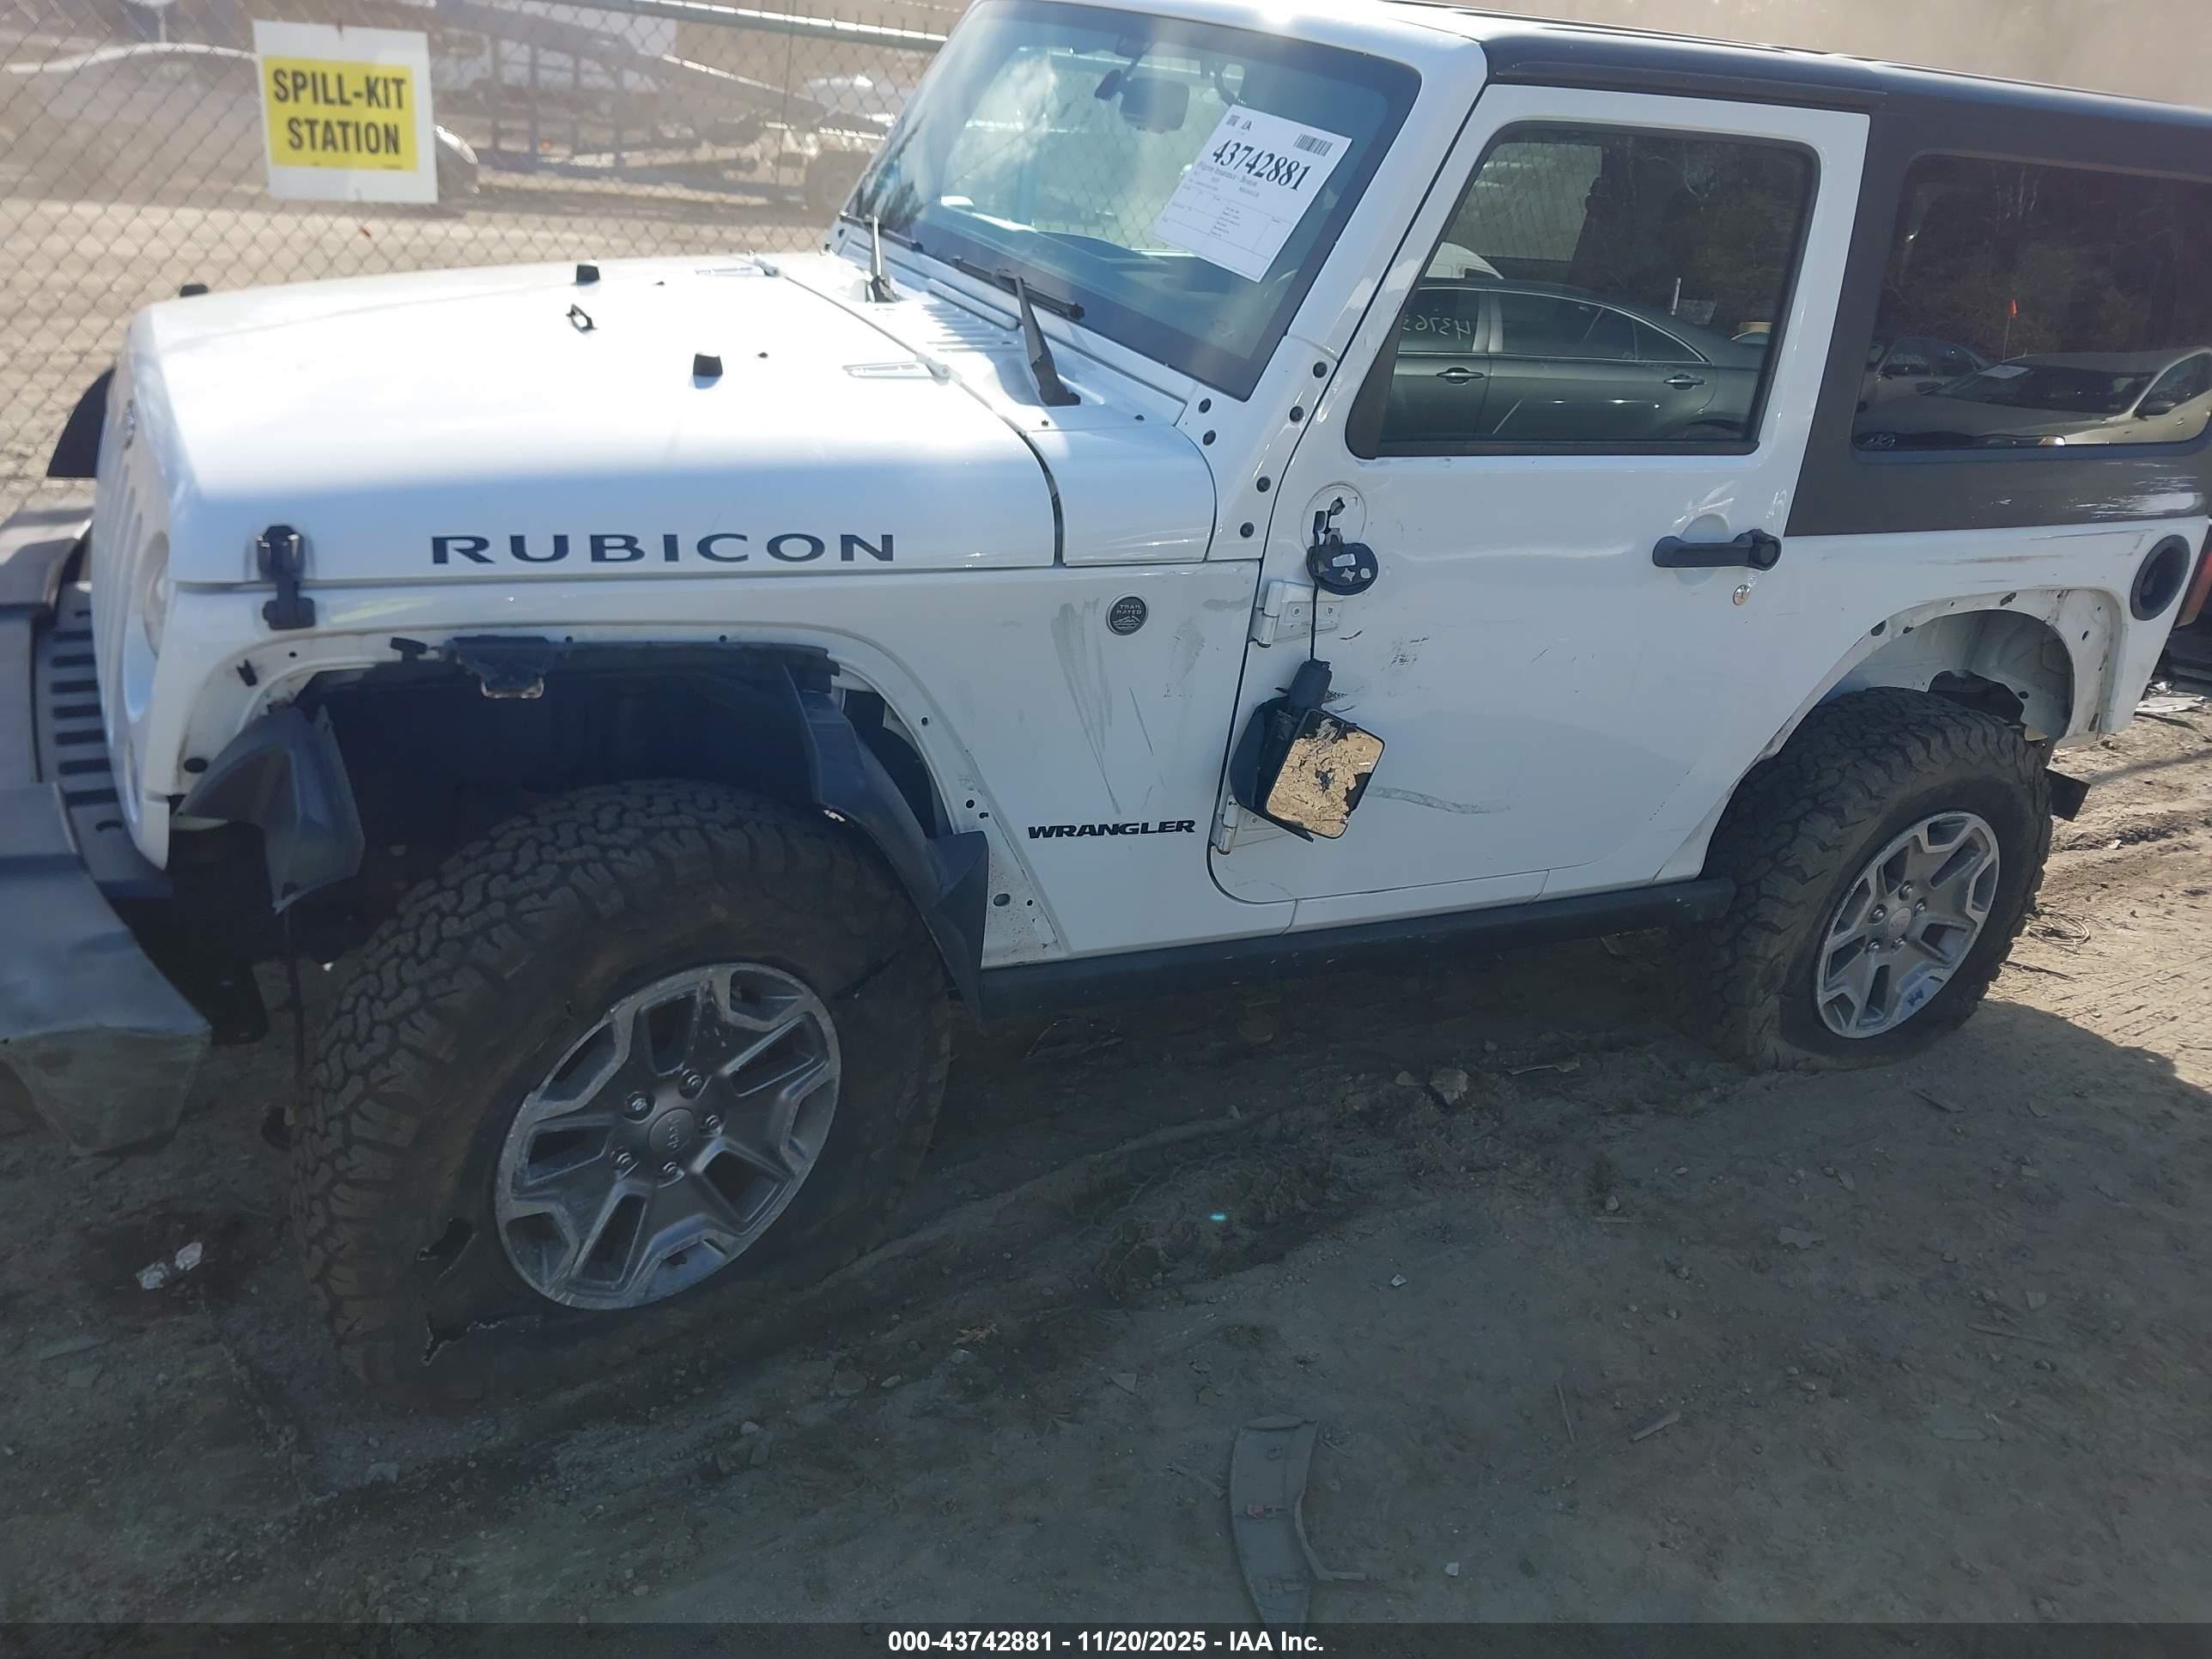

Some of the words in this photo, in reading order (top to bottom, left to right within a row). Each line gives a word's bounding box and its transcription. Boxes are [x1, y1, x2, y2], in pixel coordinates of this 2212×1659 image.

[273, 68, 405, 109] SPILL-KIT
[288, 117, 400, 155] STATION
[1212, 139, 1311, 191] 43742881
[431, 532, 894, 564] RUBICON
[1028, 819, 1195, 839] WRANGLER
